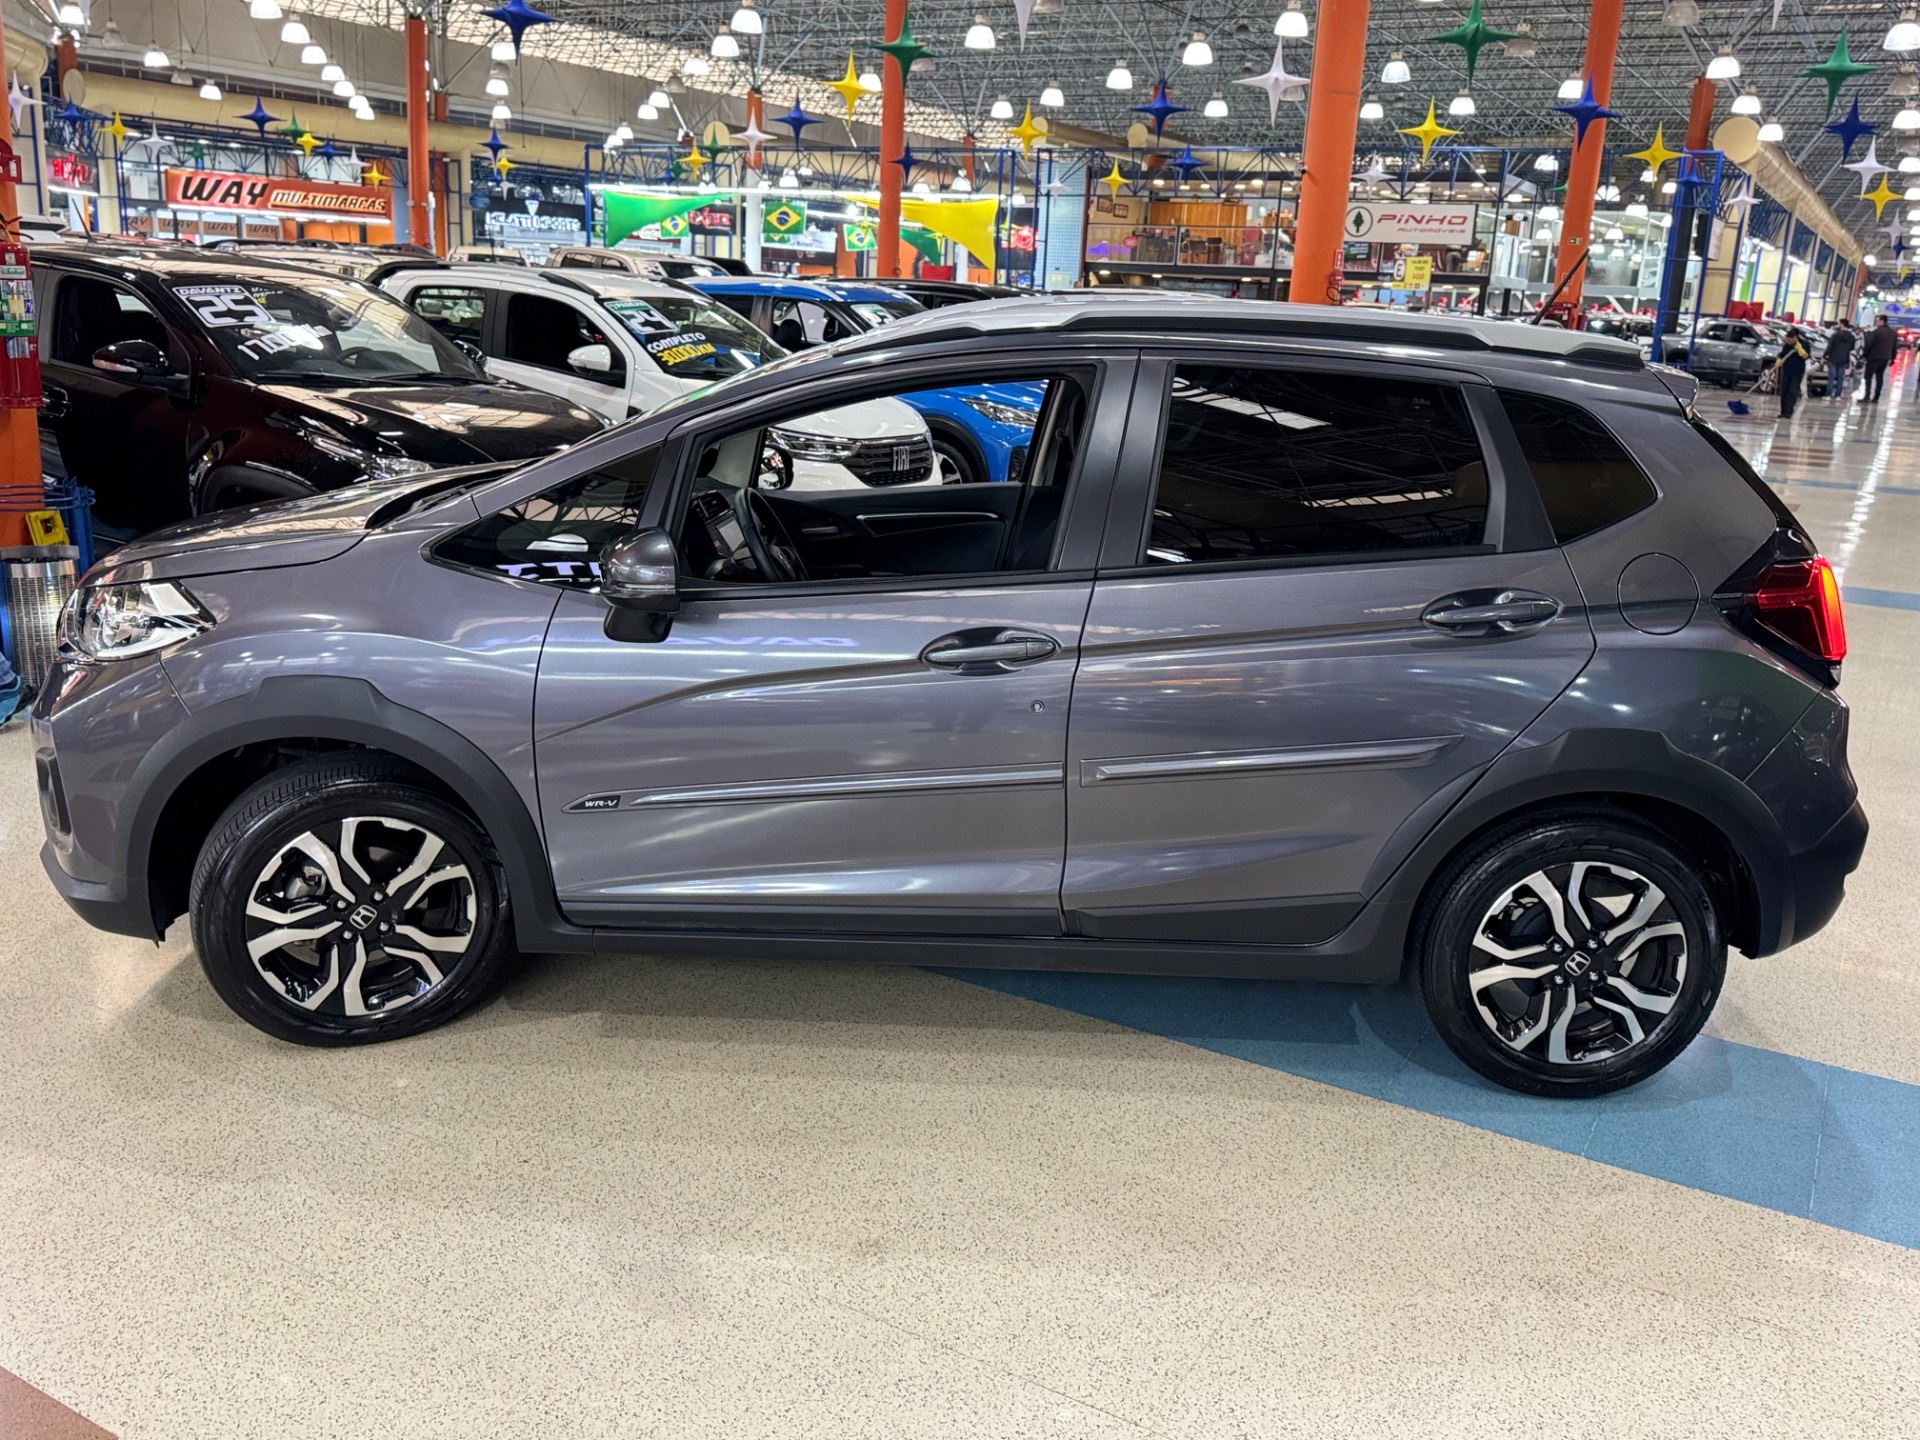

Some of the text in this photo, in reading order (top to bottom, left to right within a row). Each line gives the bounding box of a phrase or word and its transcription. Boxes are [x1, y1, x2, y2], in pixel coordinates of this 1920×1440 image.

[181, 176, 388, 212] WAY MULTIMARCAS
[128, 217, 149, 226] AY
[207, 221, 237, 232] WAY
[249, 224, 278, 234] WAY
[179, 287, 243, 296] DAVANTI
[188, 294, 271, 324] 25
[620, 309, 675, 332] 24
[646, 332, 707, 354] COMPLETO
[584, 799, 618, 808] WR-V
